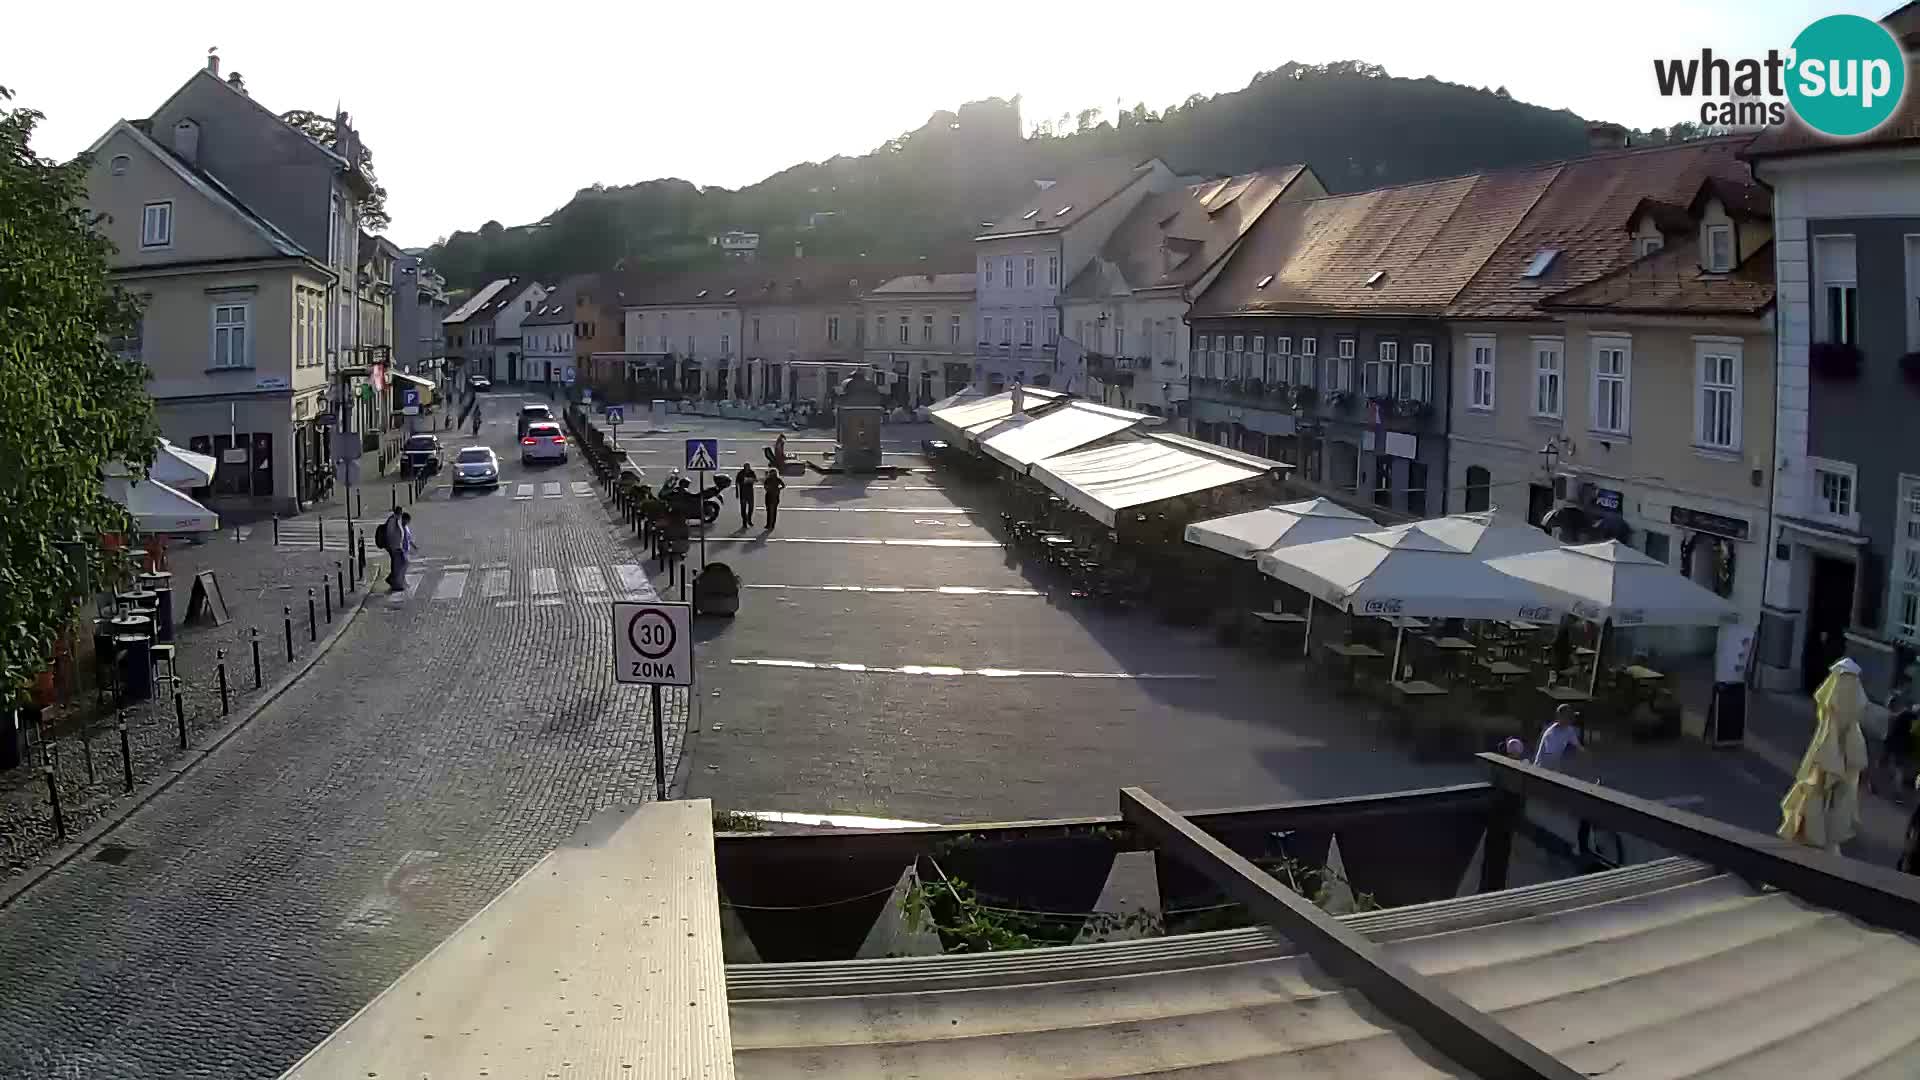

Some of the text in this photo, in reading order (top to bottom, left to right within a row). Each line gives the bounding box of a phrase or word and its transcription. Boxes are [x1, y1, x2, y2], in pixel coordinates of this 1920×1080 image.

[407, 393, 415, 404] P
[641, 624, 665, 645] 30
[631, 661, 676, 679] ZONA
